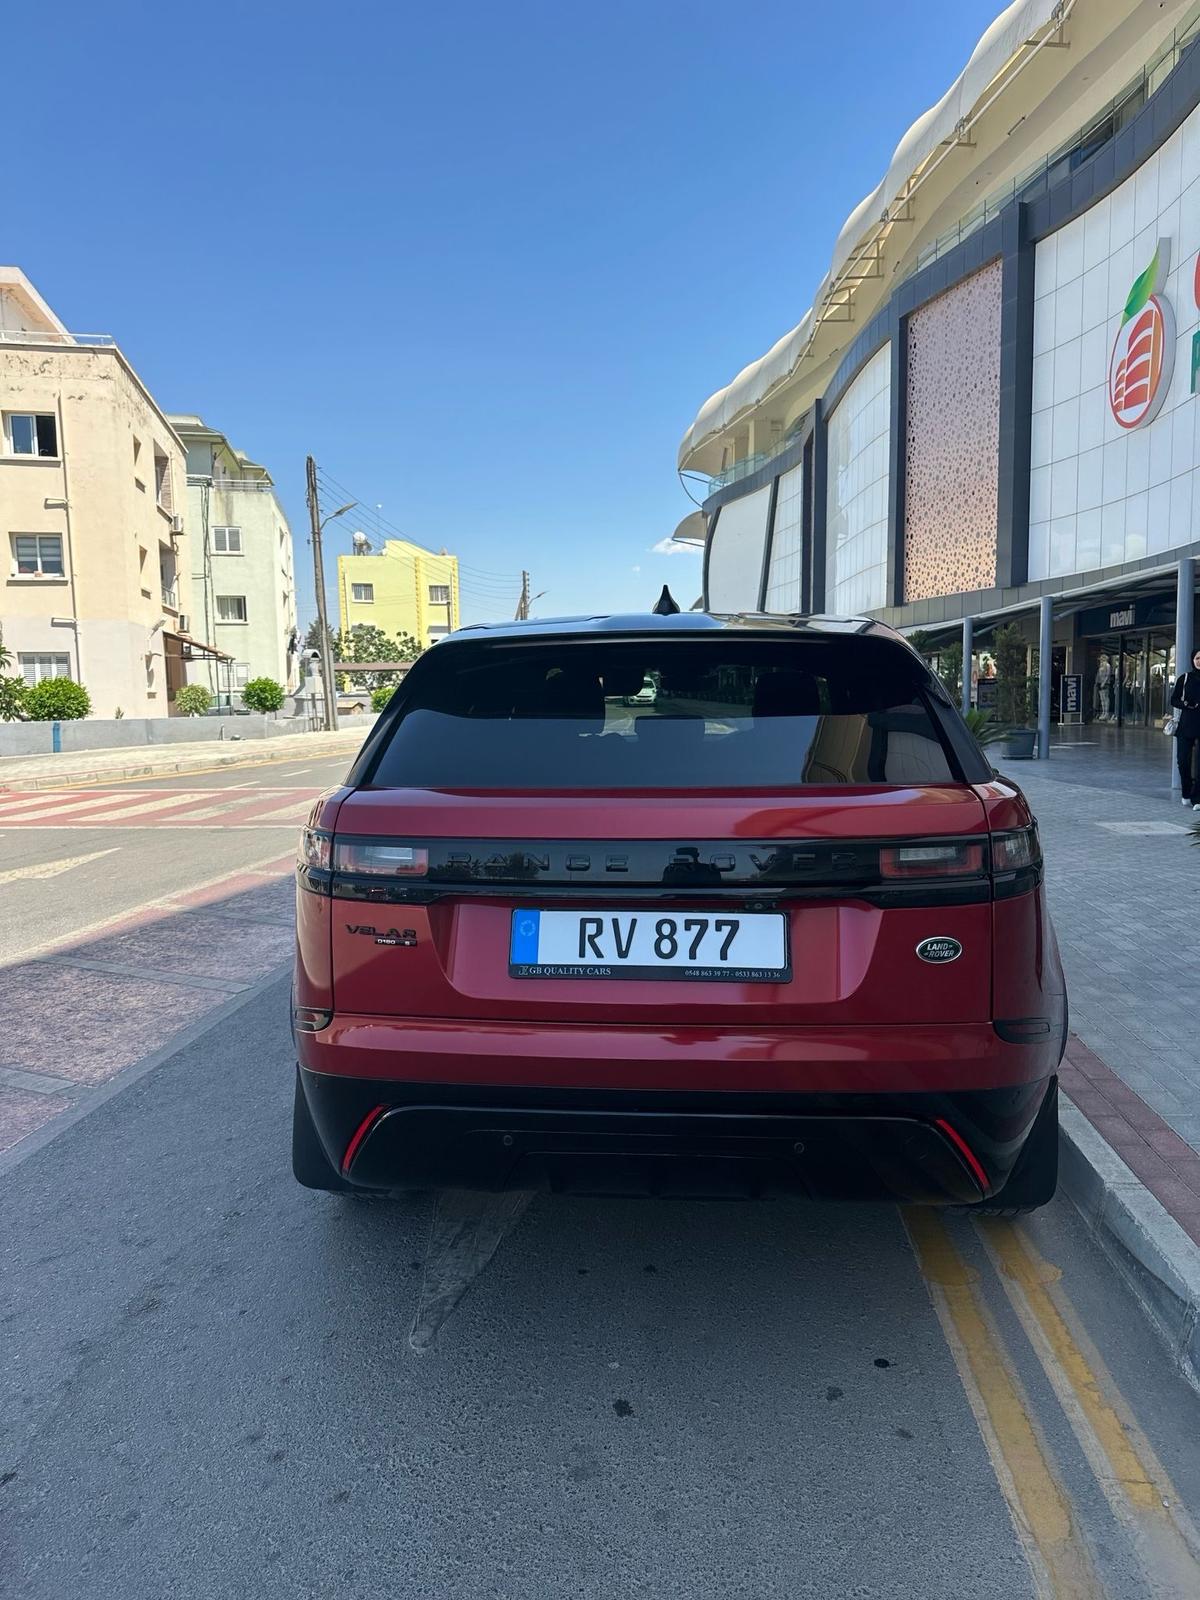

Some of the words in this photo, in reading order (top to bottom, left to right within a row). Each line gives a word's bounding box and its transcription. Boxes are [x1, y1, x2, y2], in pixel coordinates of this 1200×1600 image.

[1110, 604, 1135, 628] mavi
[1065, 677, 1077, 711] mavi
[448, 852, 629, 872] RANGE
[669, 851, 857, 872] ROVER
[345, 924, 417, 938] VELAR
[578, 917, 638, 959] RV
[654, 918, 740, 961] 877
[927, 943, 949, 951] LAND
[928, 950, 955, 958] ROVER
[529, 966, 542, 975] GB
[544, 967, 586, 977] QUALITY
[586, 967, 612, 976] CARS
